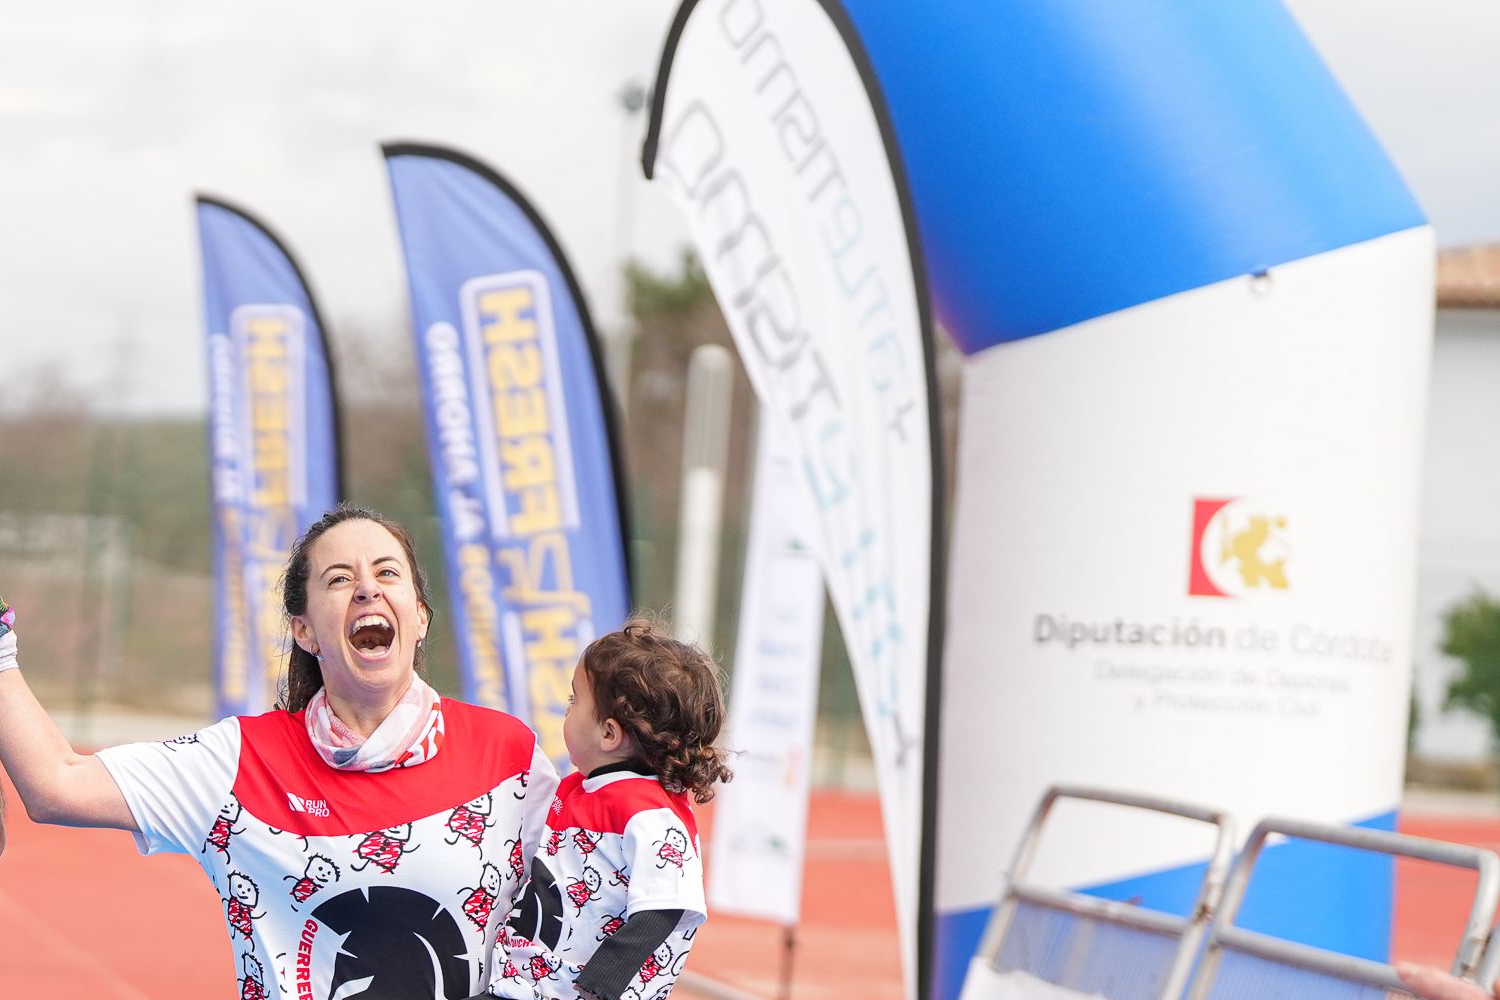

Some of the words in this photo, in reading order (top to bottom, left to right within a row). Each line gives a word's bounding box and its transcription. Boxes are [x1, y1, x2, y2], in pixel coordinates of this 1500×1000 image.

[1033, 612, 1228, 652] Diputación
[305, 799, 327, 809] RUN
[308, 807, 330, 818] PRO
